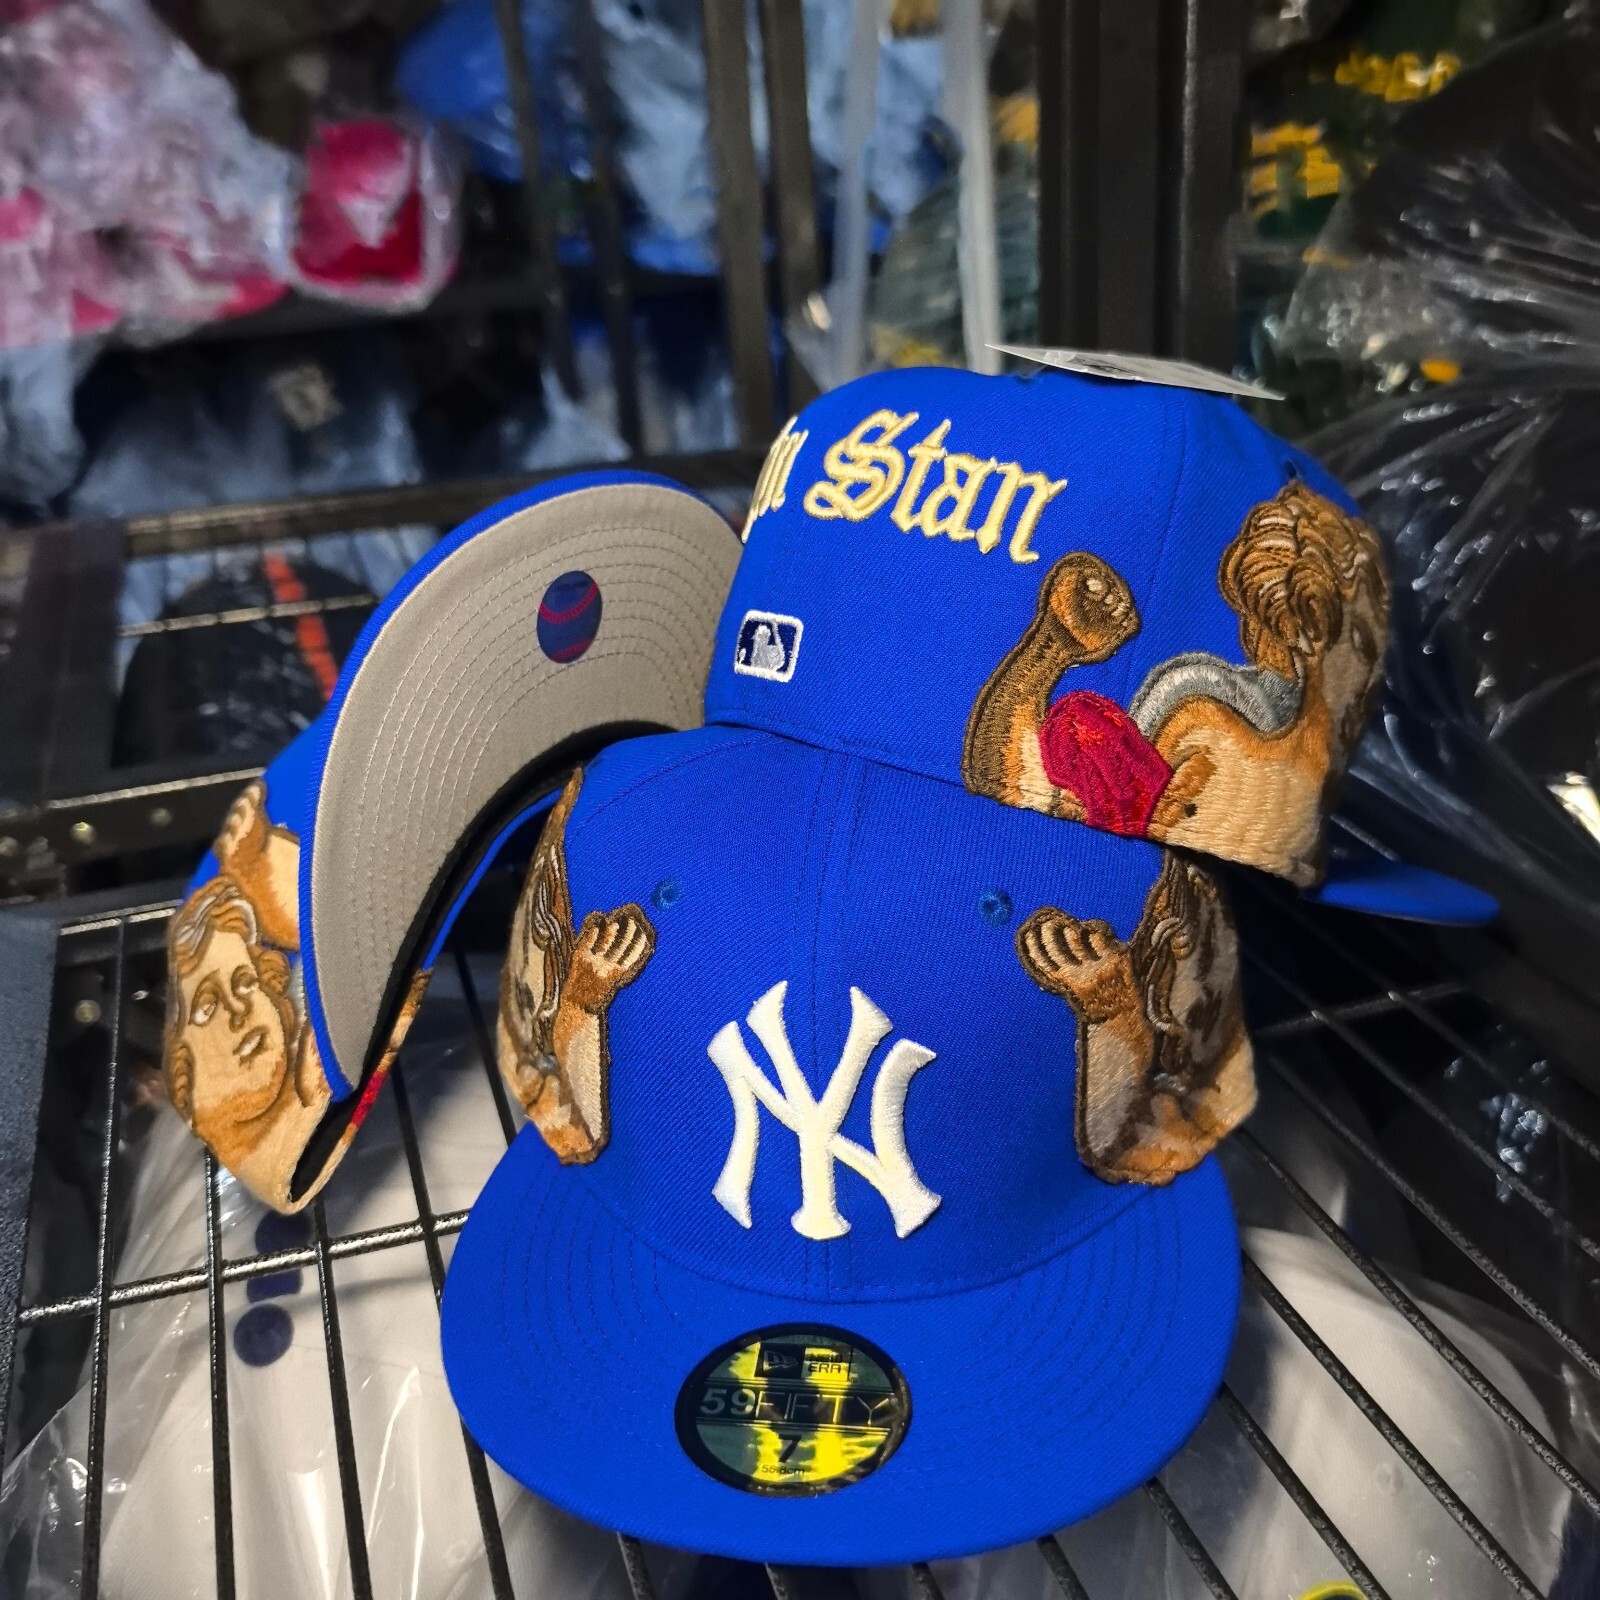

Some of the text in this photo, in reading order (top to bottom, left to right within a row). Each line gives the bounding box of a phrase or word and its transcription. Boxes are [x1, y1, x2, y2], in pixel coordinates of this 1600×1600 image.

[804, 409, 1068, 564] Stan
[706, 980, 942, 1240] NY
[808, 1362, 842, 1374] ERA
[700, 1387, 890, 1426] 59FIFTY
[779, 1433, 802, 1463] 7
